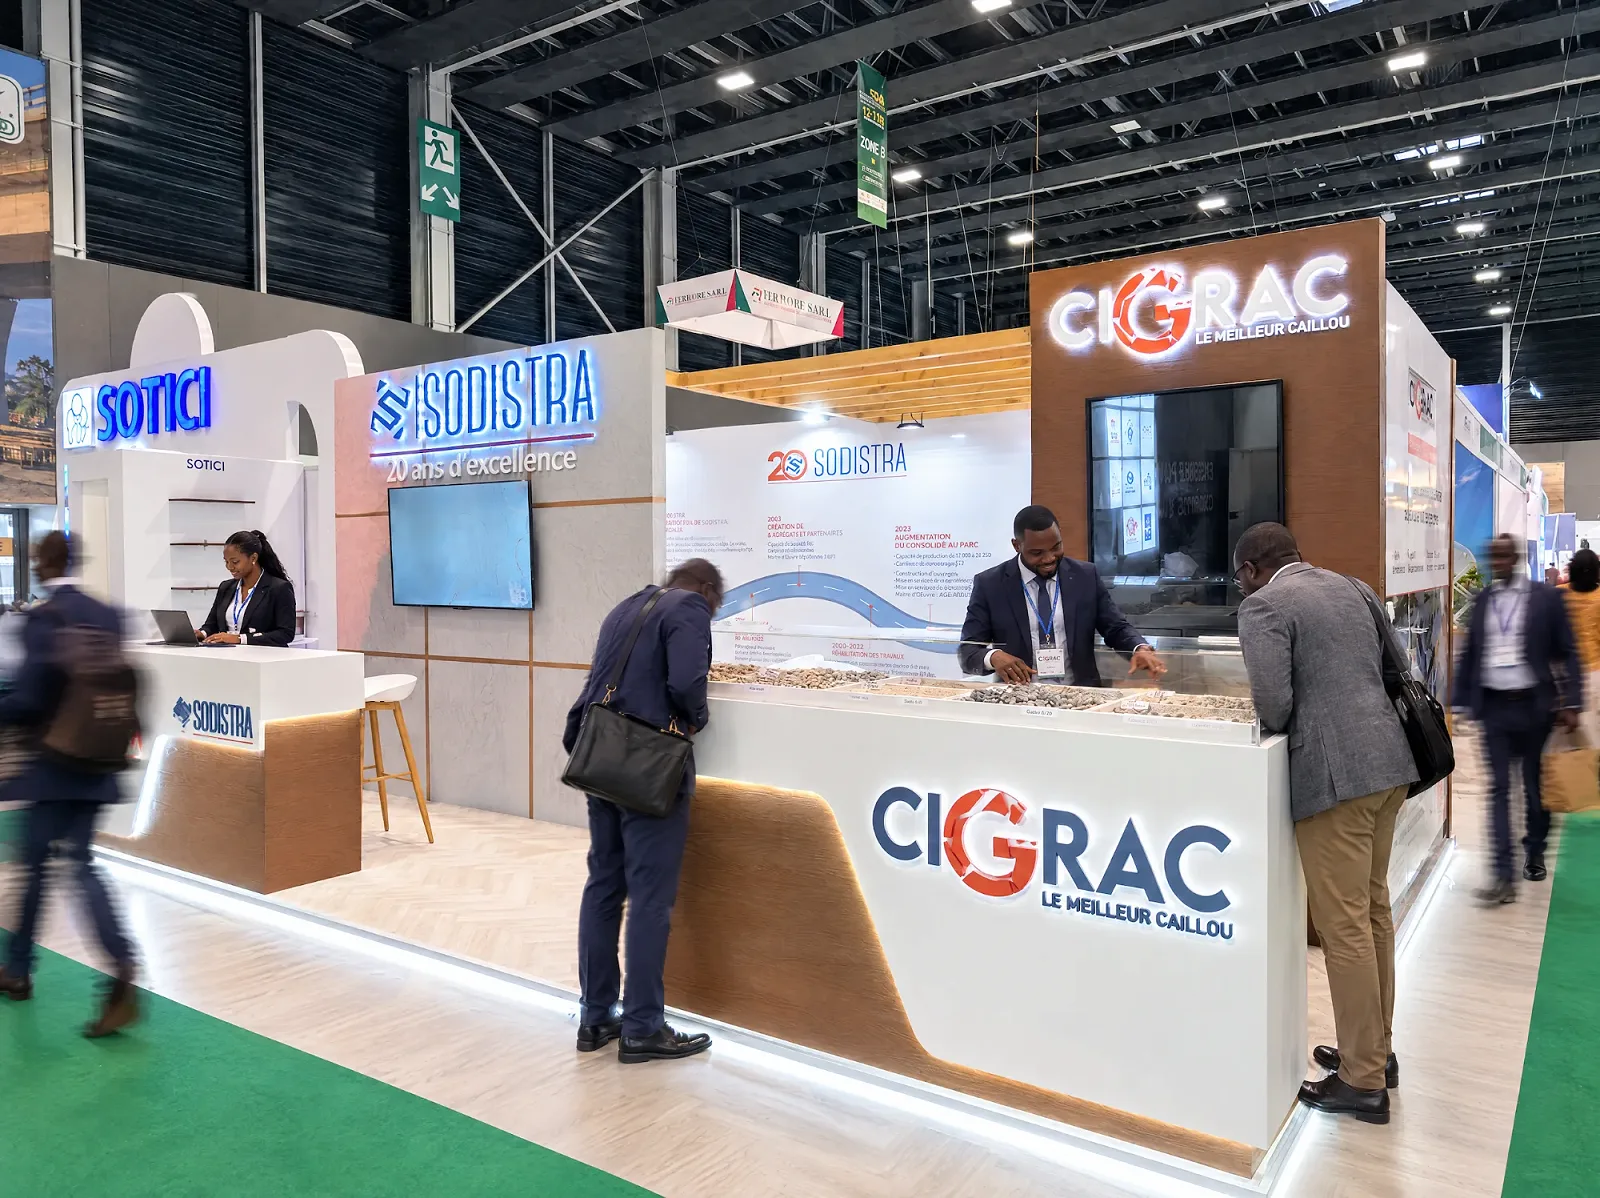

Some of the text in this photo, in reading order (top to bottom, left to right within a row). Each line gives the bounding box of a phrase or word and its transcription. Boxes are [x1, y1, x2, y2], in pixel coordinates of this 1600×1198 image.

[860, 135, 886, 159] ZONE B
[1050, 255, 1349, 355] CIGRAC
[1195, 316, 1350, 345] LE MEILLEUR CAILLOU
[97, 366, 211, 441] SOTICI
[423, 350, 595, 438] SODISTRA
[186, 458, 225, 472] SOTICI
[386, 447, 577, 483] 20 ans d'excellence
[814, 442, 907, 477] SODISTRA
[895, 525, 911, 533] 2023
[895, 533, 951, 541] AUGMENTATION
[906, 541, 946, 549] CONSOLIDÉ
[192, 699, 253, 739] SODISTRA
[872, 786, 1233, 913] CIGRAC
[1041, 890, 1234, 941] LE MEILLEUR CAILLOU
